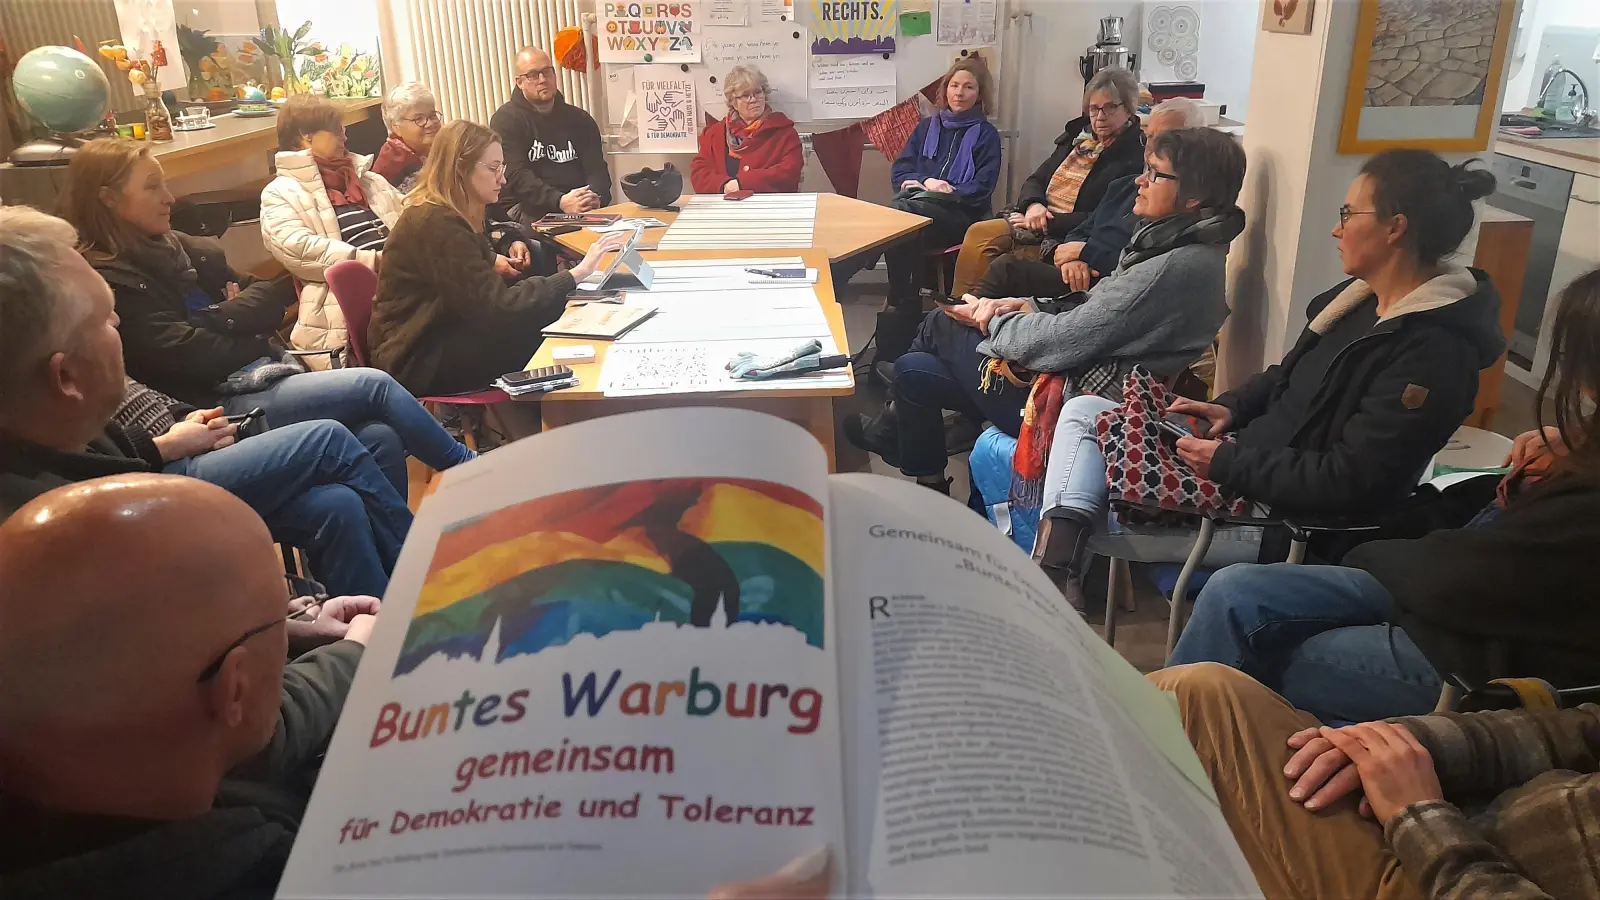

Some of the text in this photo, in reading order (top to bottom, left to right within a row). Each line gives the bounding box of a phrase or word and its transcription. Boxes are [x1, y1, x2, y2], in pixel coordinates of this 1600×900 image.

[822, 1, 884, 21] RECHTS.
[642, 80, 686, 91] FÜR VIELFALT
[868, 523, 982, 560] Gemeinsam
[369, 666, 824, 748] Buntes Warburg
[451, 738, 675, 793] gemeinsam
[338, 793, 815, 844] für Demokratie und Toleranz
